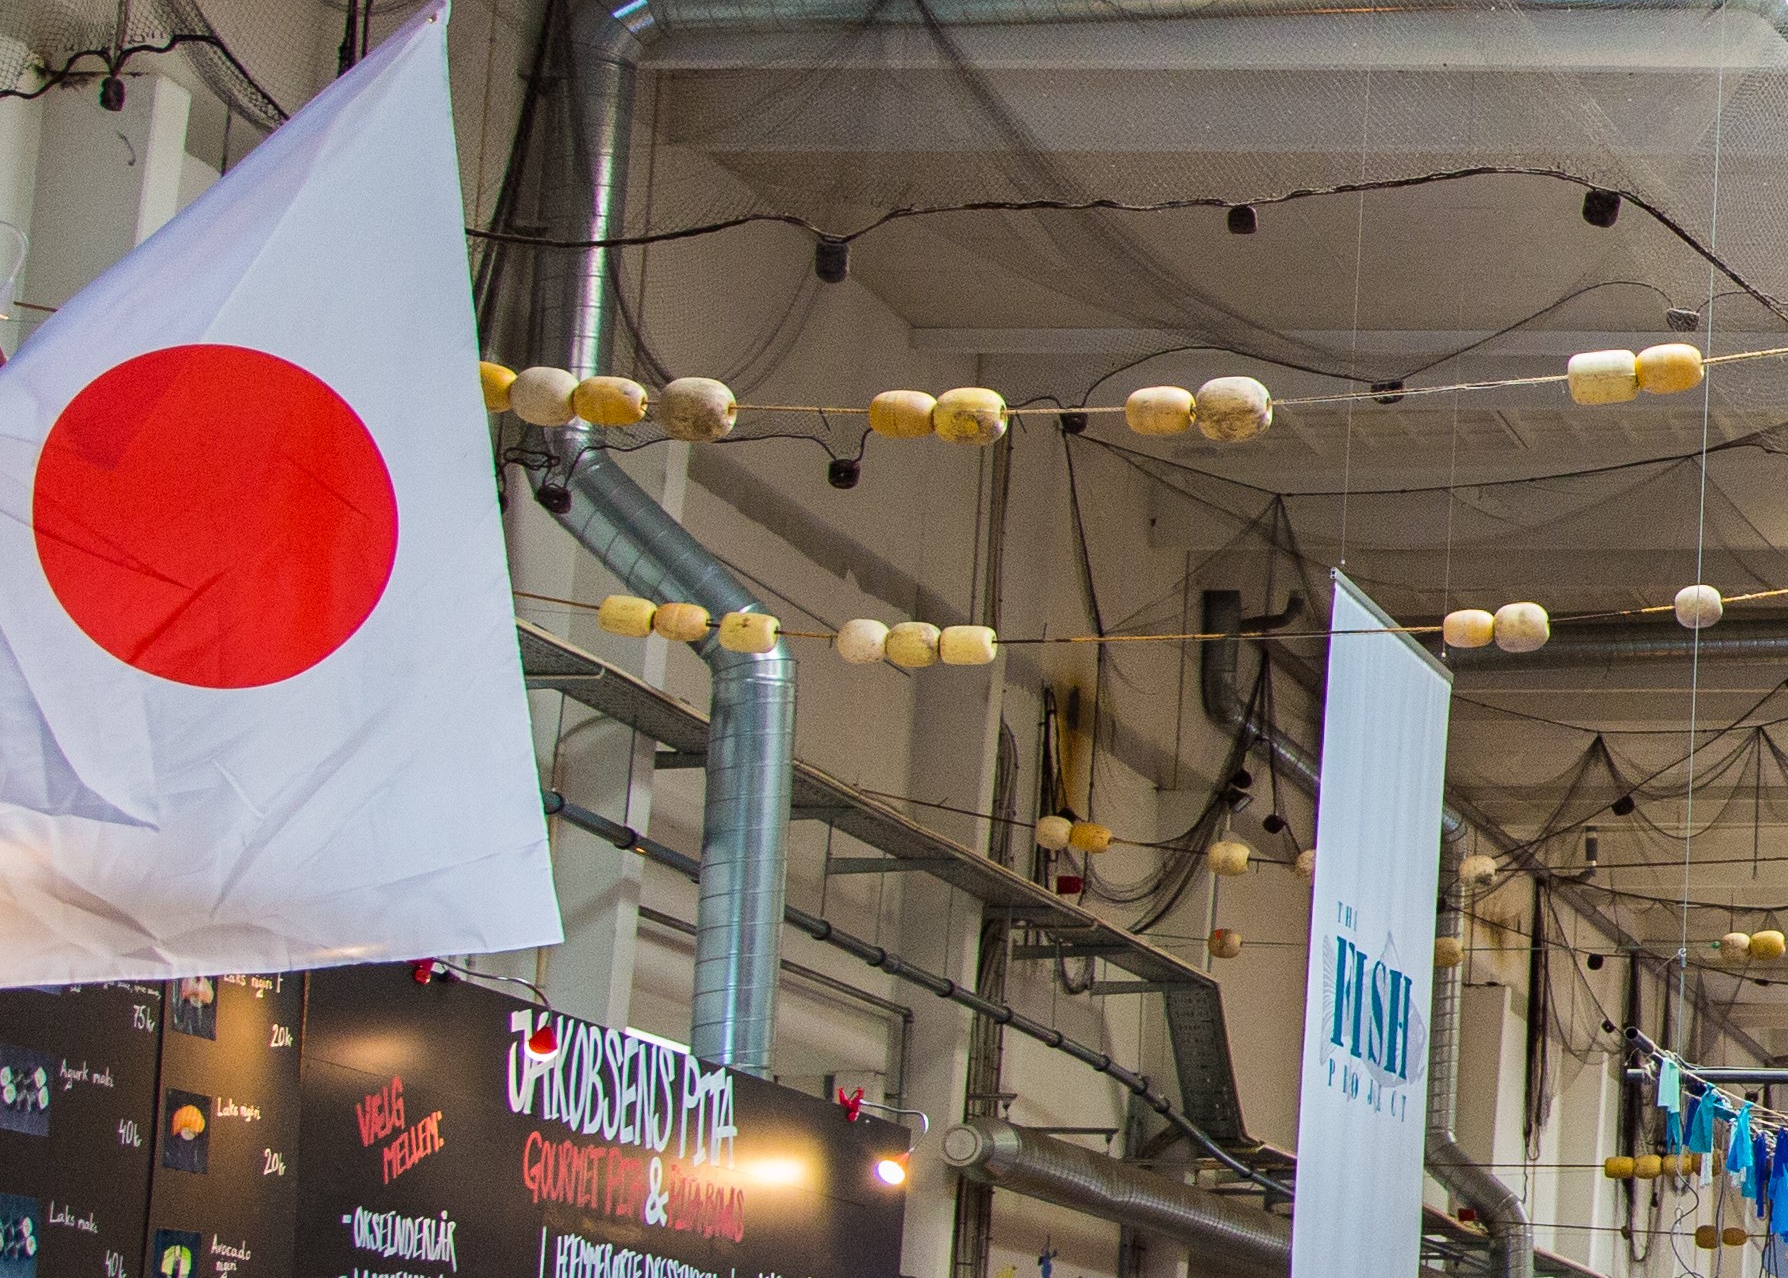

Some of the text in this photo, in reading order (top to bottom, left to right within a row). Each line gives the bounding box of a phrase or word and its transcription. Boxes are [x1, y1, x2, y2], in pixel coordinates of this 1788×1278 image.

[1330, 935, 1413, 1081] FISH
[217, 1097, 238, 1117] Laks
[677, 1053, 738, 1170] PITA
[522, 1130, 600, 1205] GOURMET
[645, 1156, 669, 1227] &
[49, 1200, 75, 1226] Laks
[211, 1234, 251, 1260] Avocado
